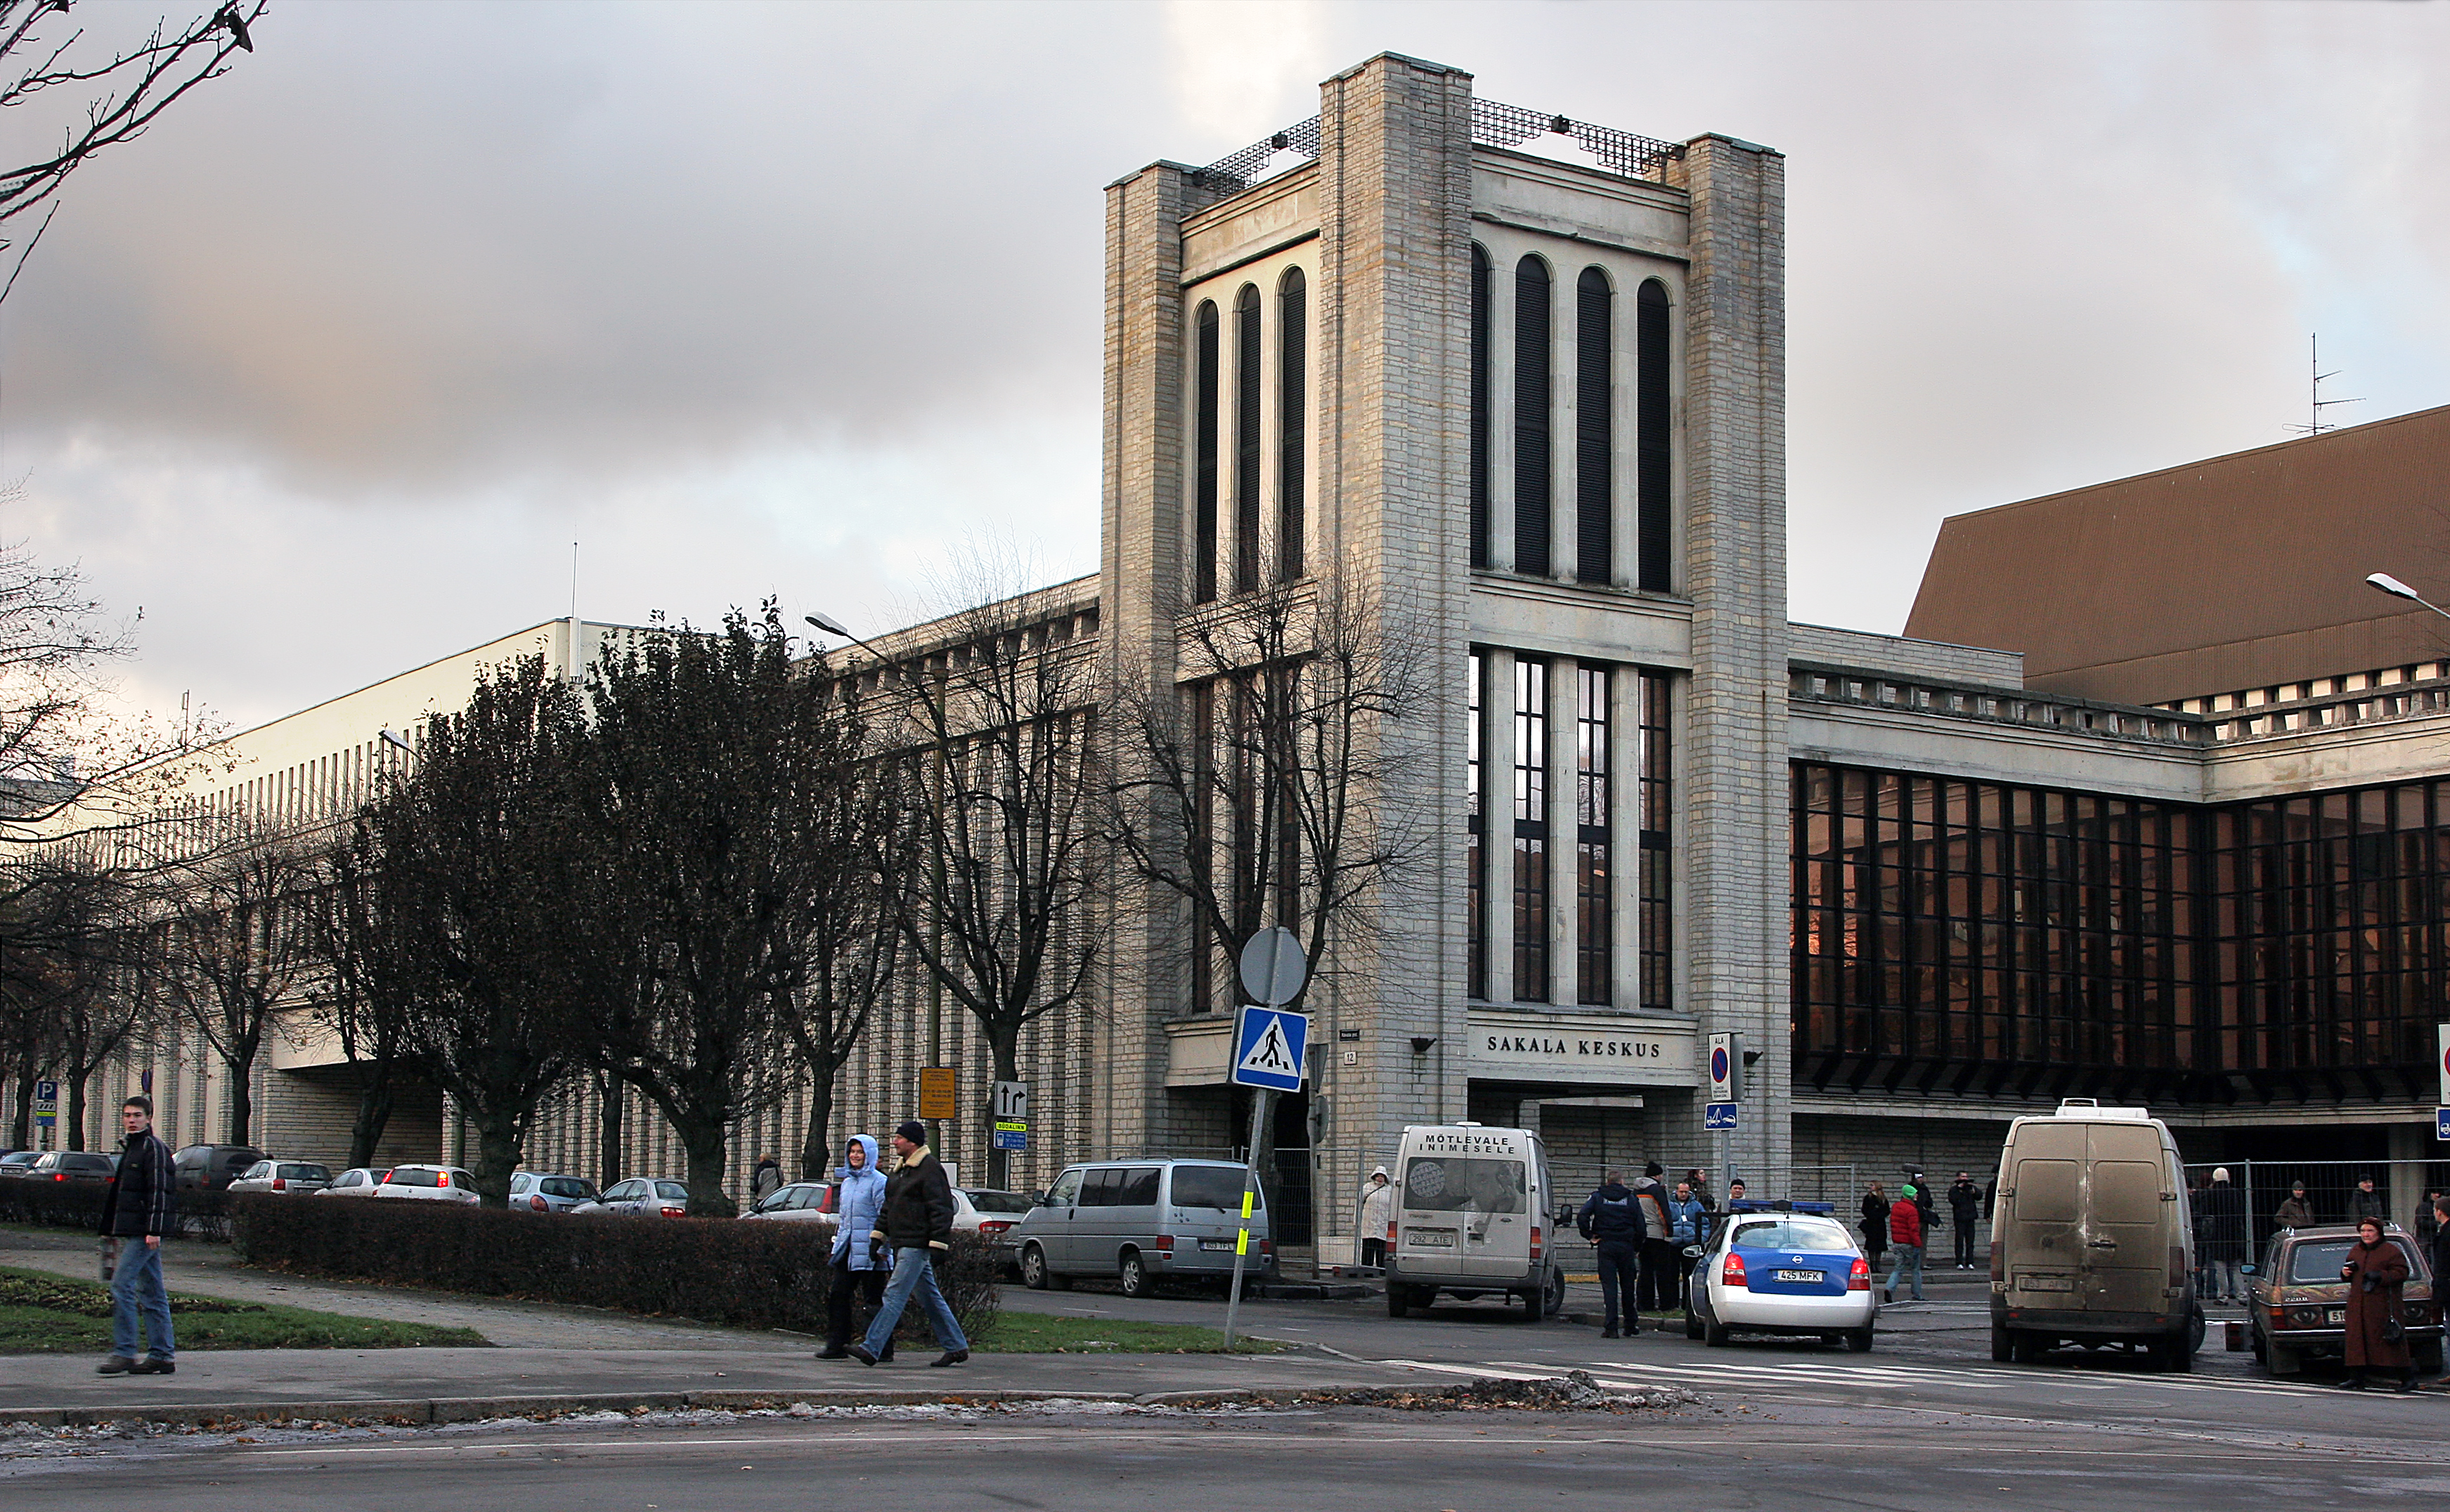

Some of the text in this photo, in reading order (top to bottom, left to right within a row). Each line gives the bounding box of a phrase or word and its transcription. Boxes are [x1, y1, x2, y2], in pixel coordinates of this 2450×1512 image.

[1488, 1036, 1659, 1057] SAKALA KESKUS
[1347, 1053, 1354, 1062] 12
[1420, 1144, 1515, 1154] INIMESELE
[1782, 1271, 1819, 1280] 425 MFK
[2332, 1312, 2345, 1321] 51
